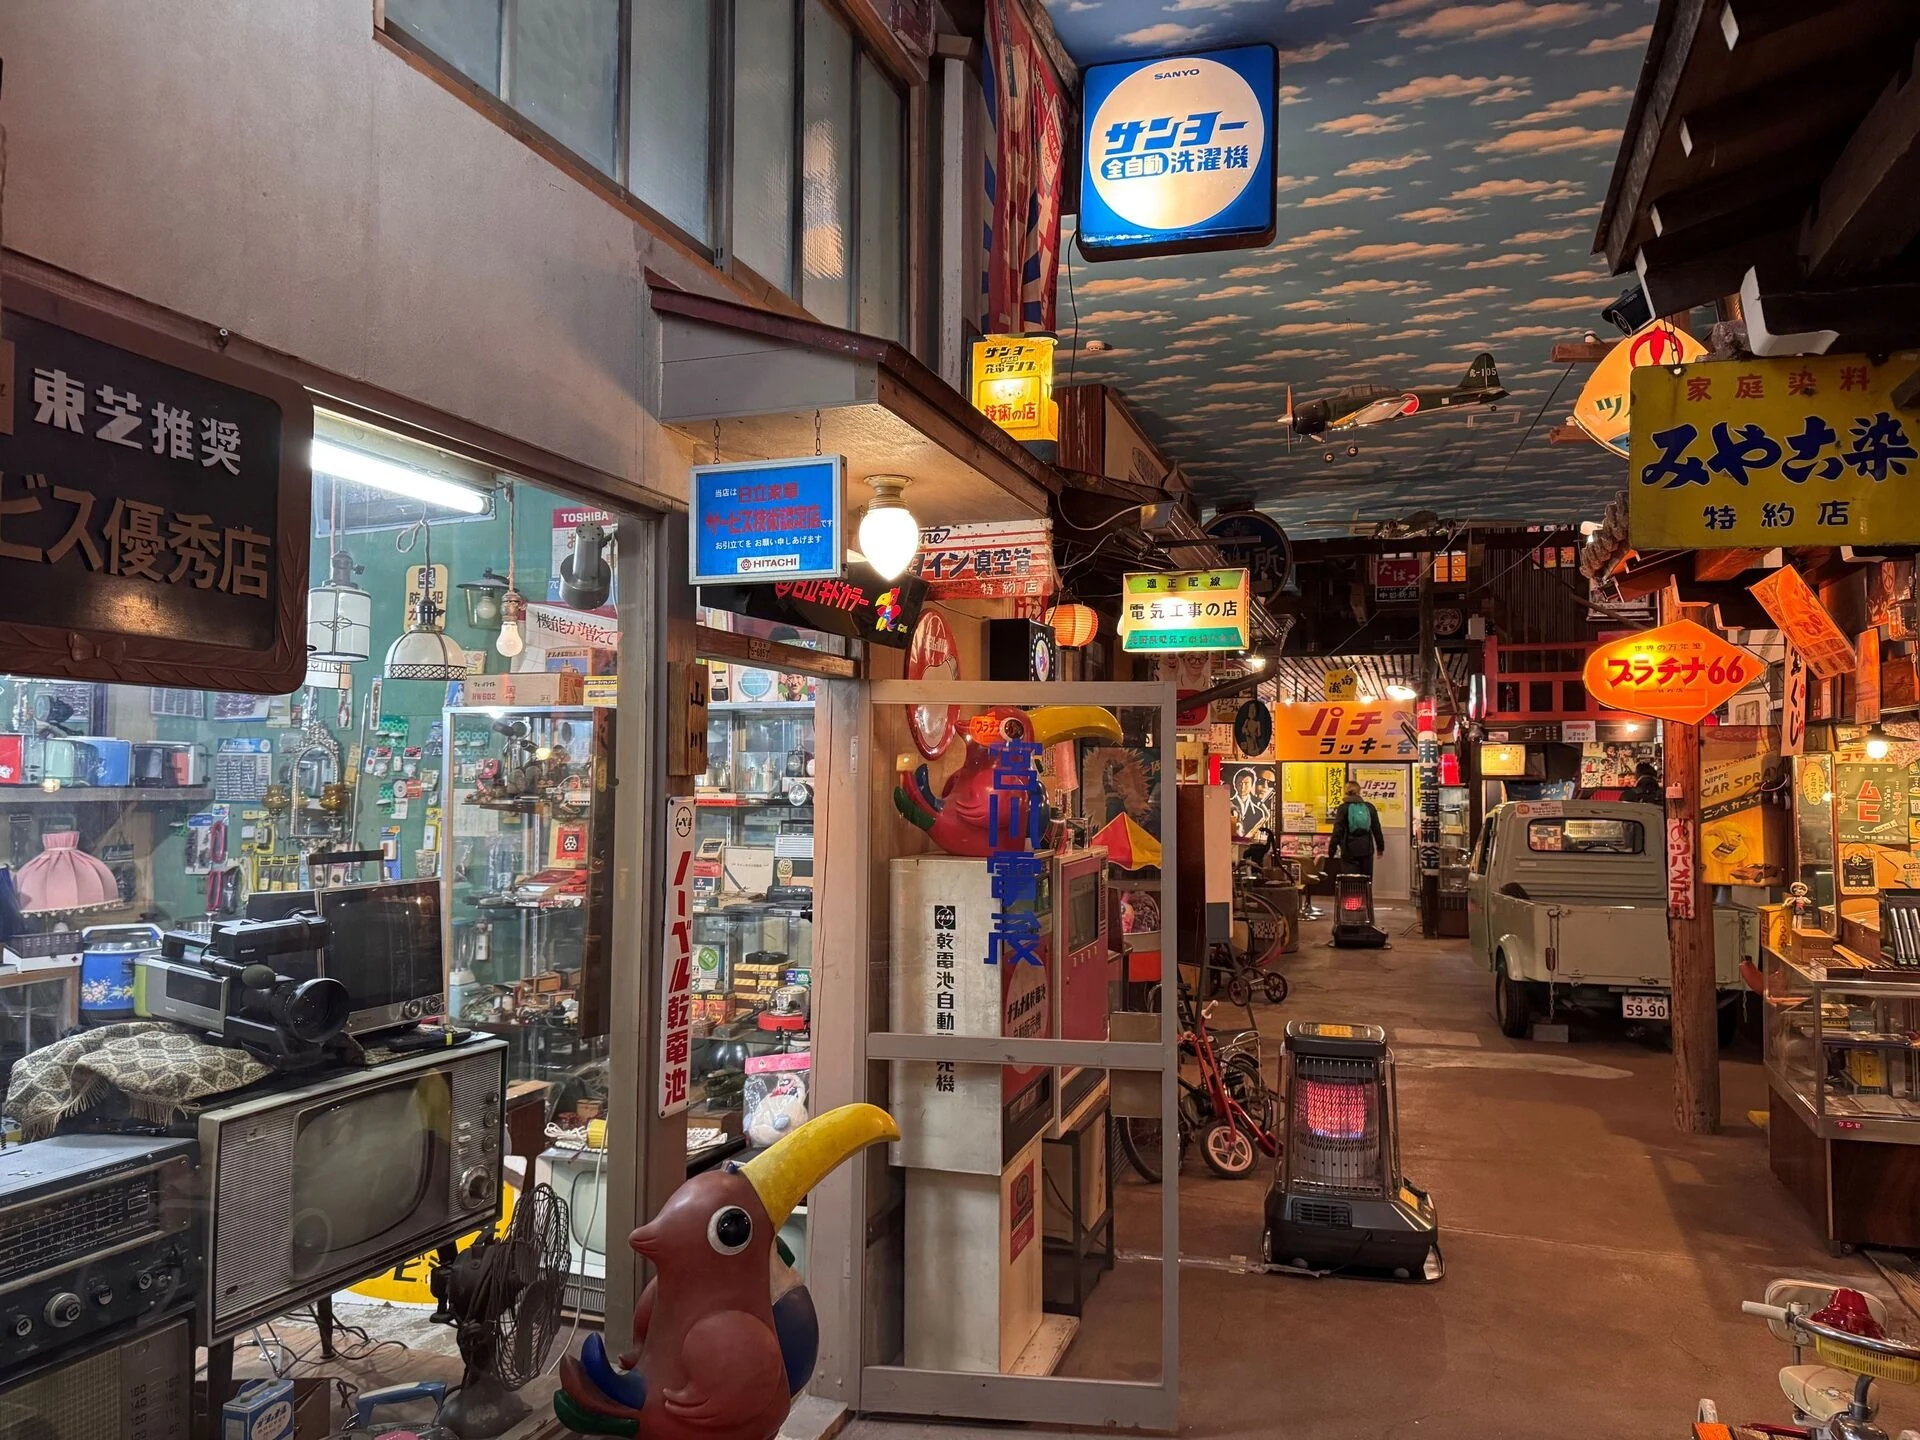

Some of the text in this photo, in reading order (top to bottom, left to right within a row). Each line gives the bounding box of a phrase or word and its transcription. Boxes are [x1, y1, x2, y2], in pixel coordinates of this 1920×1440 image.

[1154, 69, 1200, 81] SANYO
[1105, 110, 1249, 155] サンヨー
[985, 346, 1035, 358] サンヨー
[1686, 365, 1870, 402] 家庭染料
[984, 402, 1036, 421] 技術の店
[33, 367, 241, 476] 東芝推奨
[561, 511, 609, 523] TOSHIBA
[1703, 501, 1851, 530] 特約店
[754, 558, 797, 568] HITACHI
[1147, 577, 1221, 588] 適正配線
[1130, 600, 1237, 620] 電気工事の店
[536, 611, 615, 646] 機能が増えて
[1320, 737, 1414, 755] ラッキー会
[1362, 780, 1397, 789] パチンコ
[1704, 772, 1729, 786] NIPPE
[1701, 781, 1730, 798] CAR
[1856, 780, 1882, 822] ムヒ
[1704, 804, 1729, 819] ニッペ
[664, 851, 692, 1107] ノーベル乾電池
[936, 933, 955, 1092] 乾電池自動売機
[1626, 1004, 1666, 1017] 59-90
